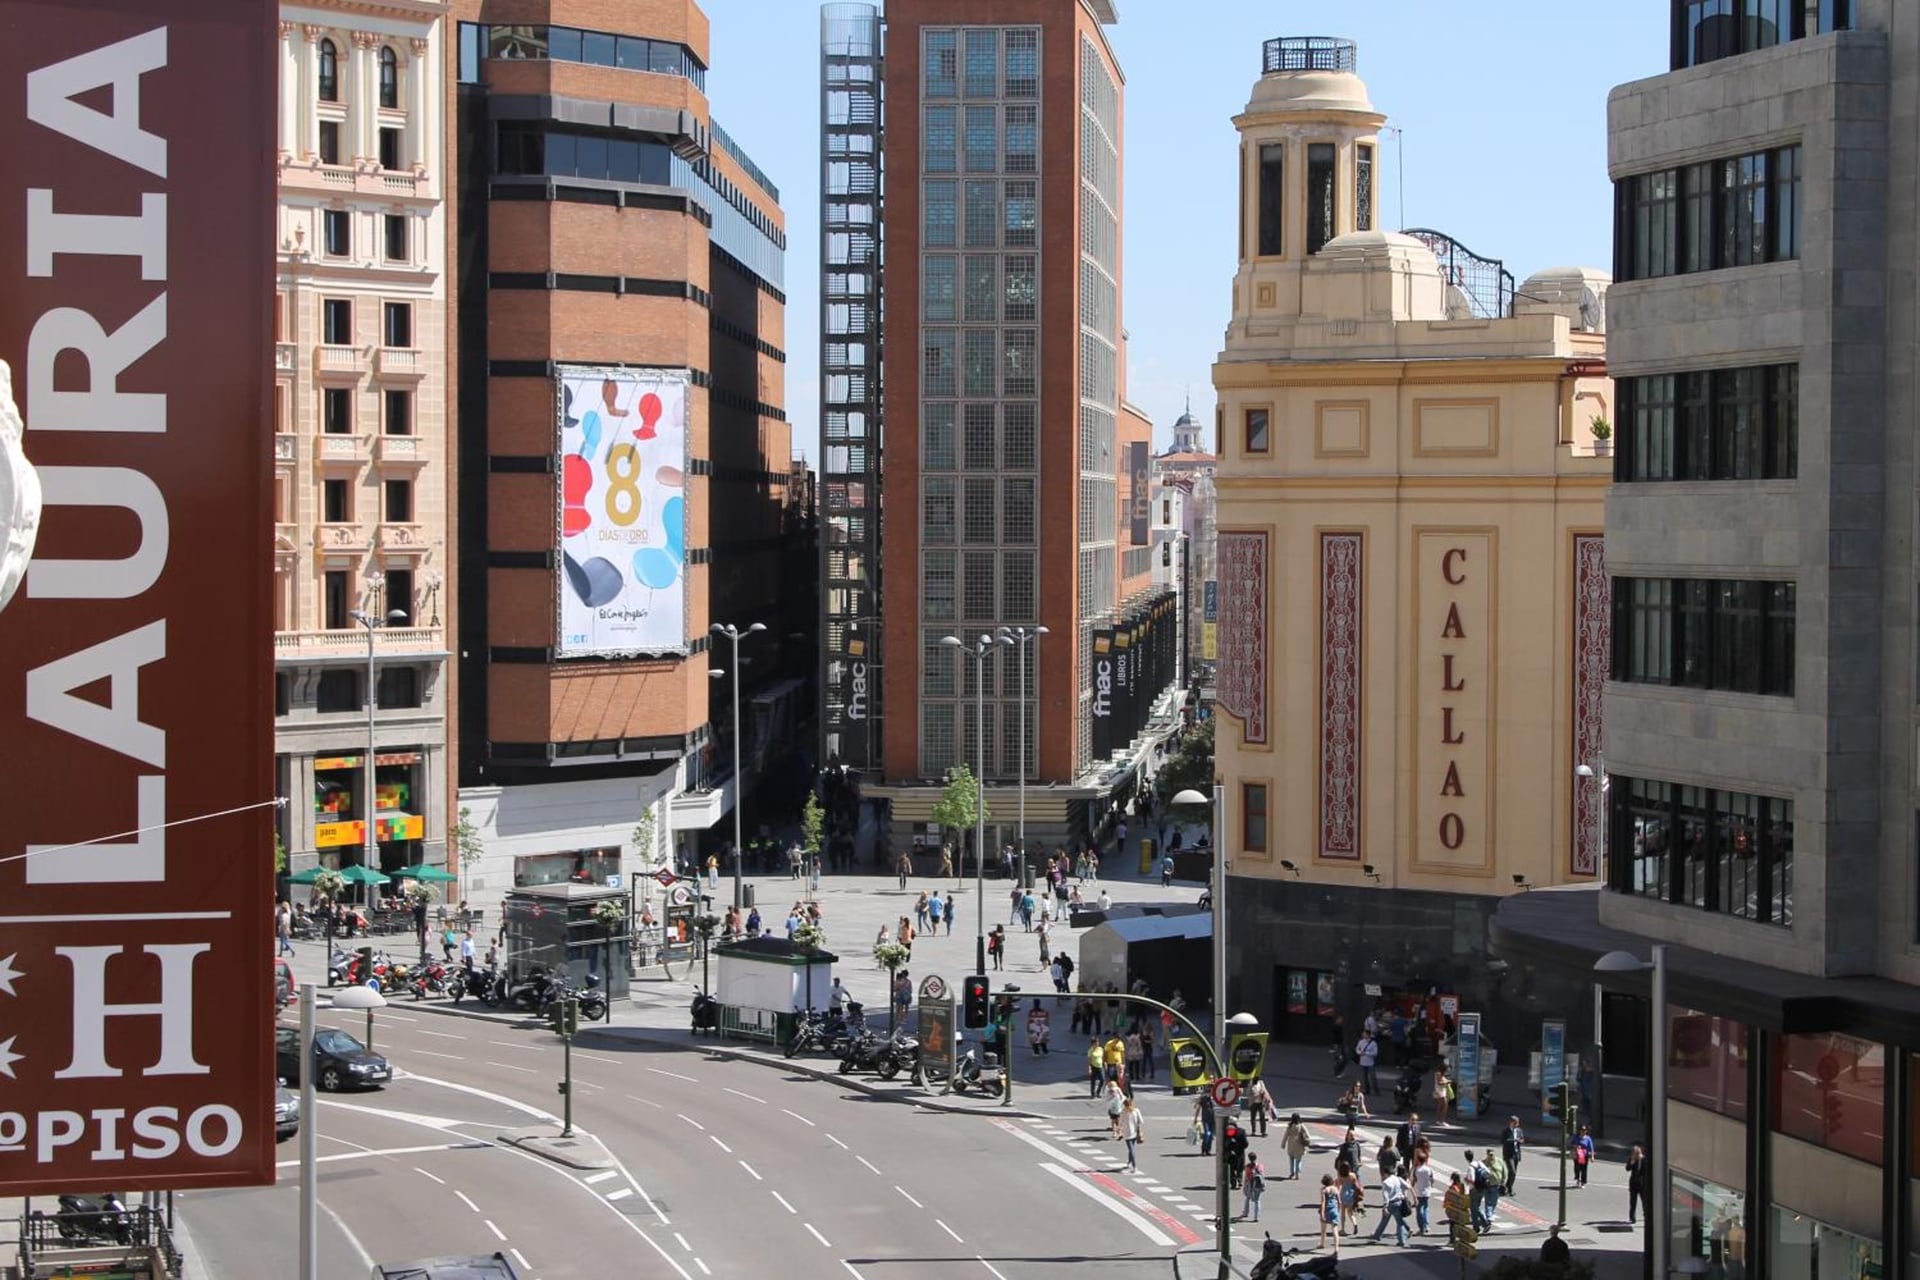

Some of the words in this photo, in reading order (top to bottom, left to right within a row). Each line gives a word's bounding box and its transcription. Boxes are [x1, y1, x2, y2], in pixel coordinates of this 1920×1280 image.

[26, 26, 169, 884] LAURIA
[606, 443, 642, 526] 8
[1132, 468, 1148, 520] fnac
[848, 662, 866, 720] fnac
[1092, 660, 1111, 718] fnac
[1117, 654, 1127, 686] LIBROS
[1439, 548, 1466, 850] CALLAO
[54, 942, 211, 1079] H
